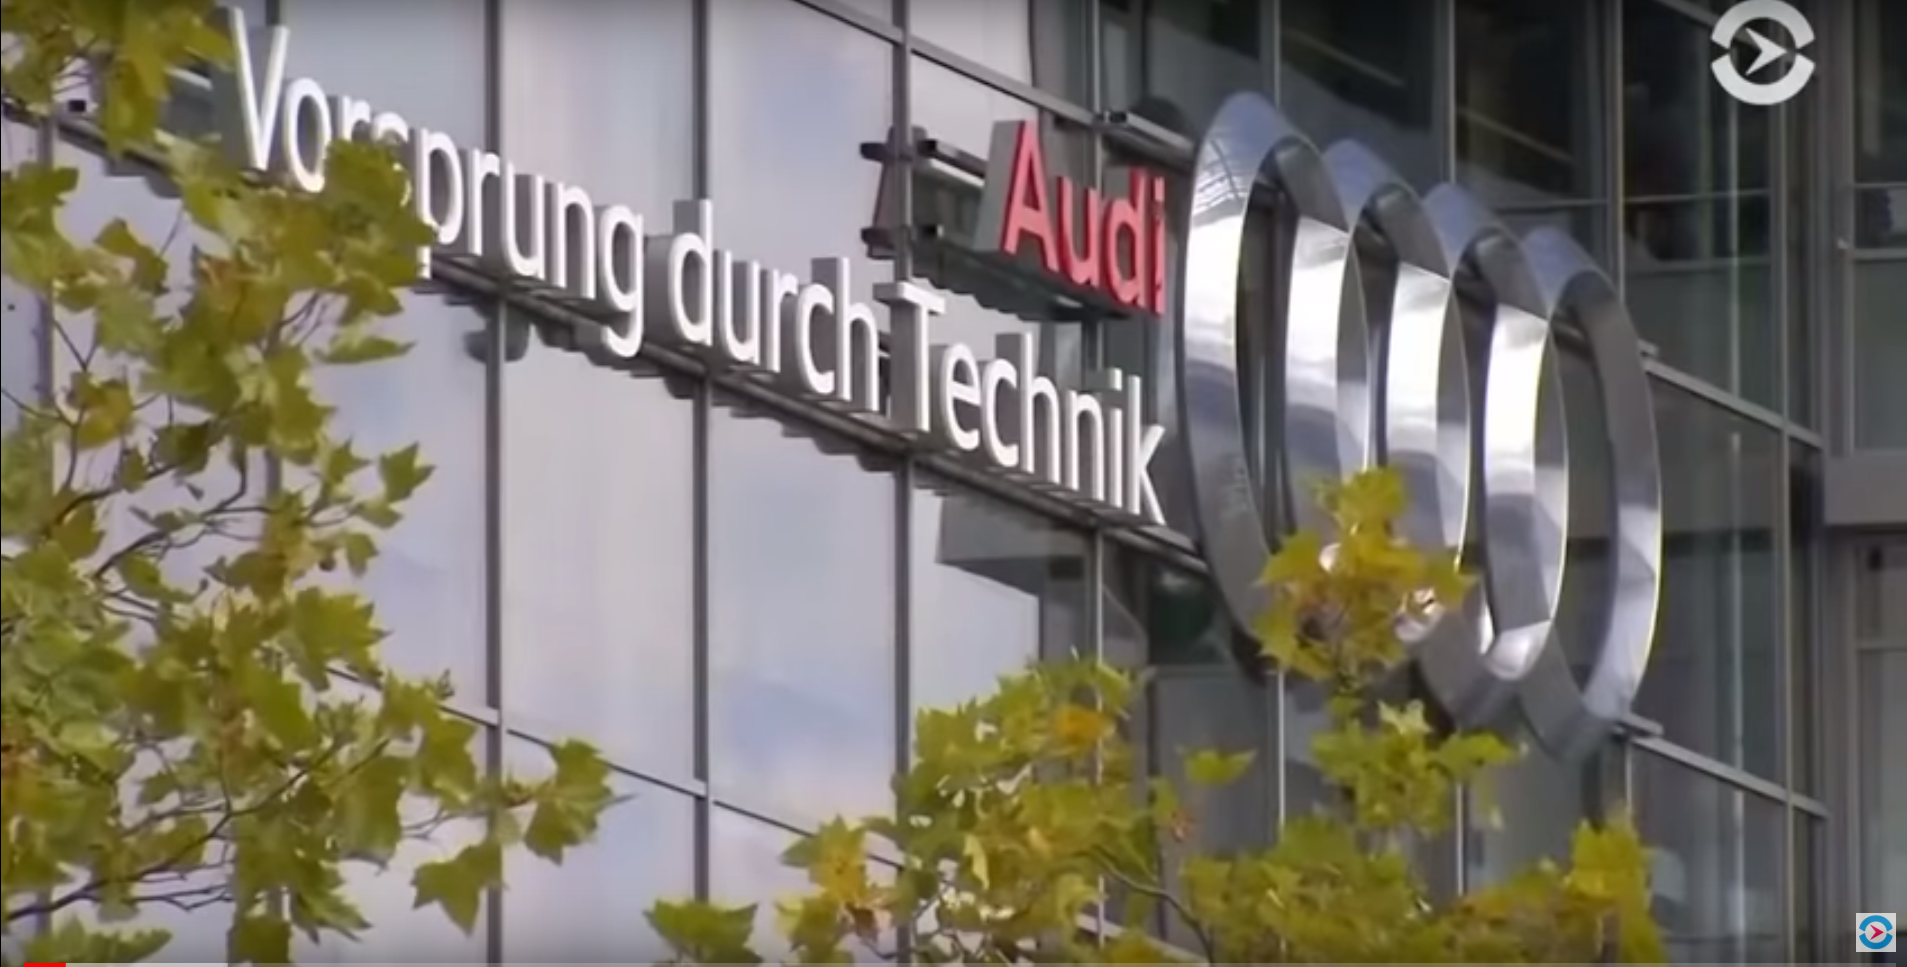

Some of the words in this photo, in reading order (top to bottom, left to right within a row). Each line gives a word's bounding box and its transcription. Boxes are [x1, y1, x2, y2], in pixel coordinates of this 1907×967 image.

[1002, 120, 1166, 315] Audi
[670, 199, 879, 412] durch
[899, 281, 1166, 526] Technik
